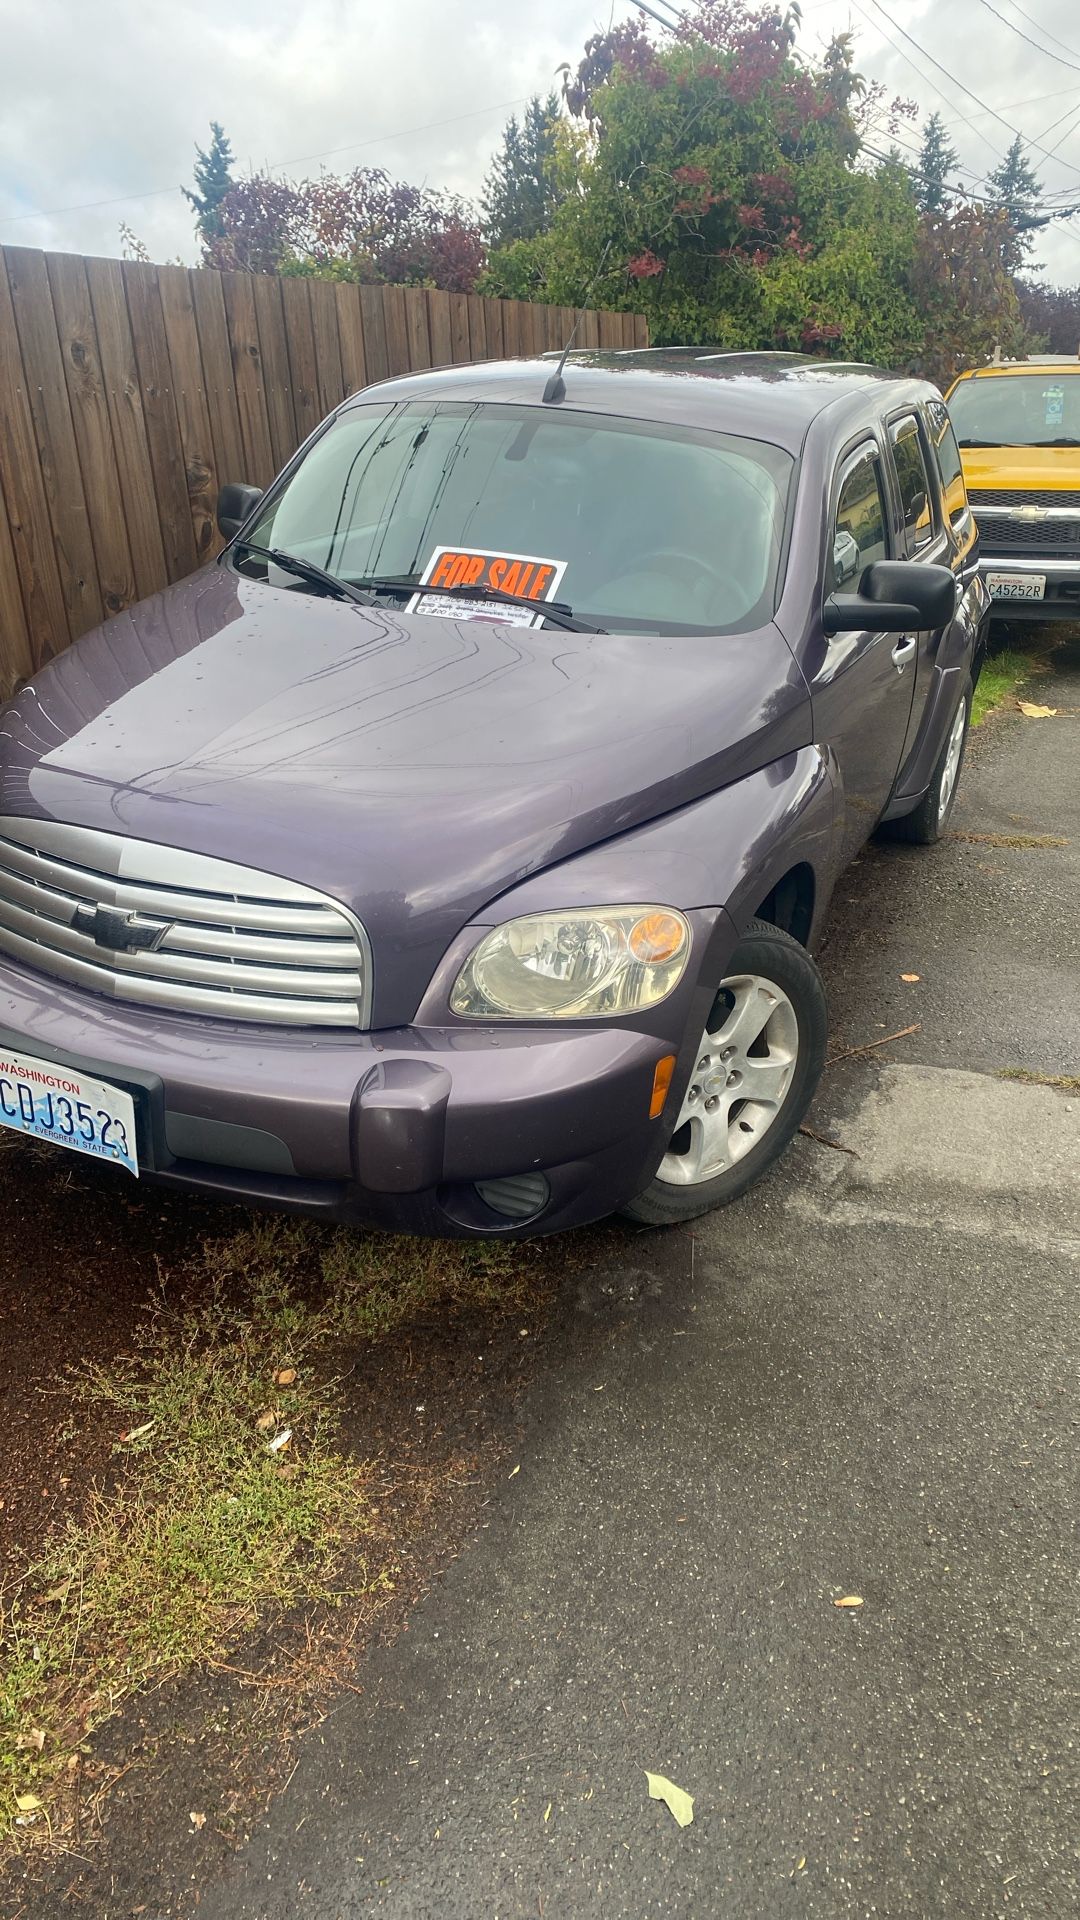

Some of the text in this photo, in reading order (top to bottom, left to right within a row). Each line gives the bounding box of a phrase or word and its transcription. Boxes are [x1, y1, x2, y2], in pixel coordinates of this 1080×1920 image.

[430, 554, 552, 600] FOR SALE
[988, 584, 1041, 597] C45252R
[0, 1062, 81, 1095] WASHINGTON
[0, 1078, 129, 1157] CDJ3523
[34, 1125, 108, 1154] EVERGREEN STATE
